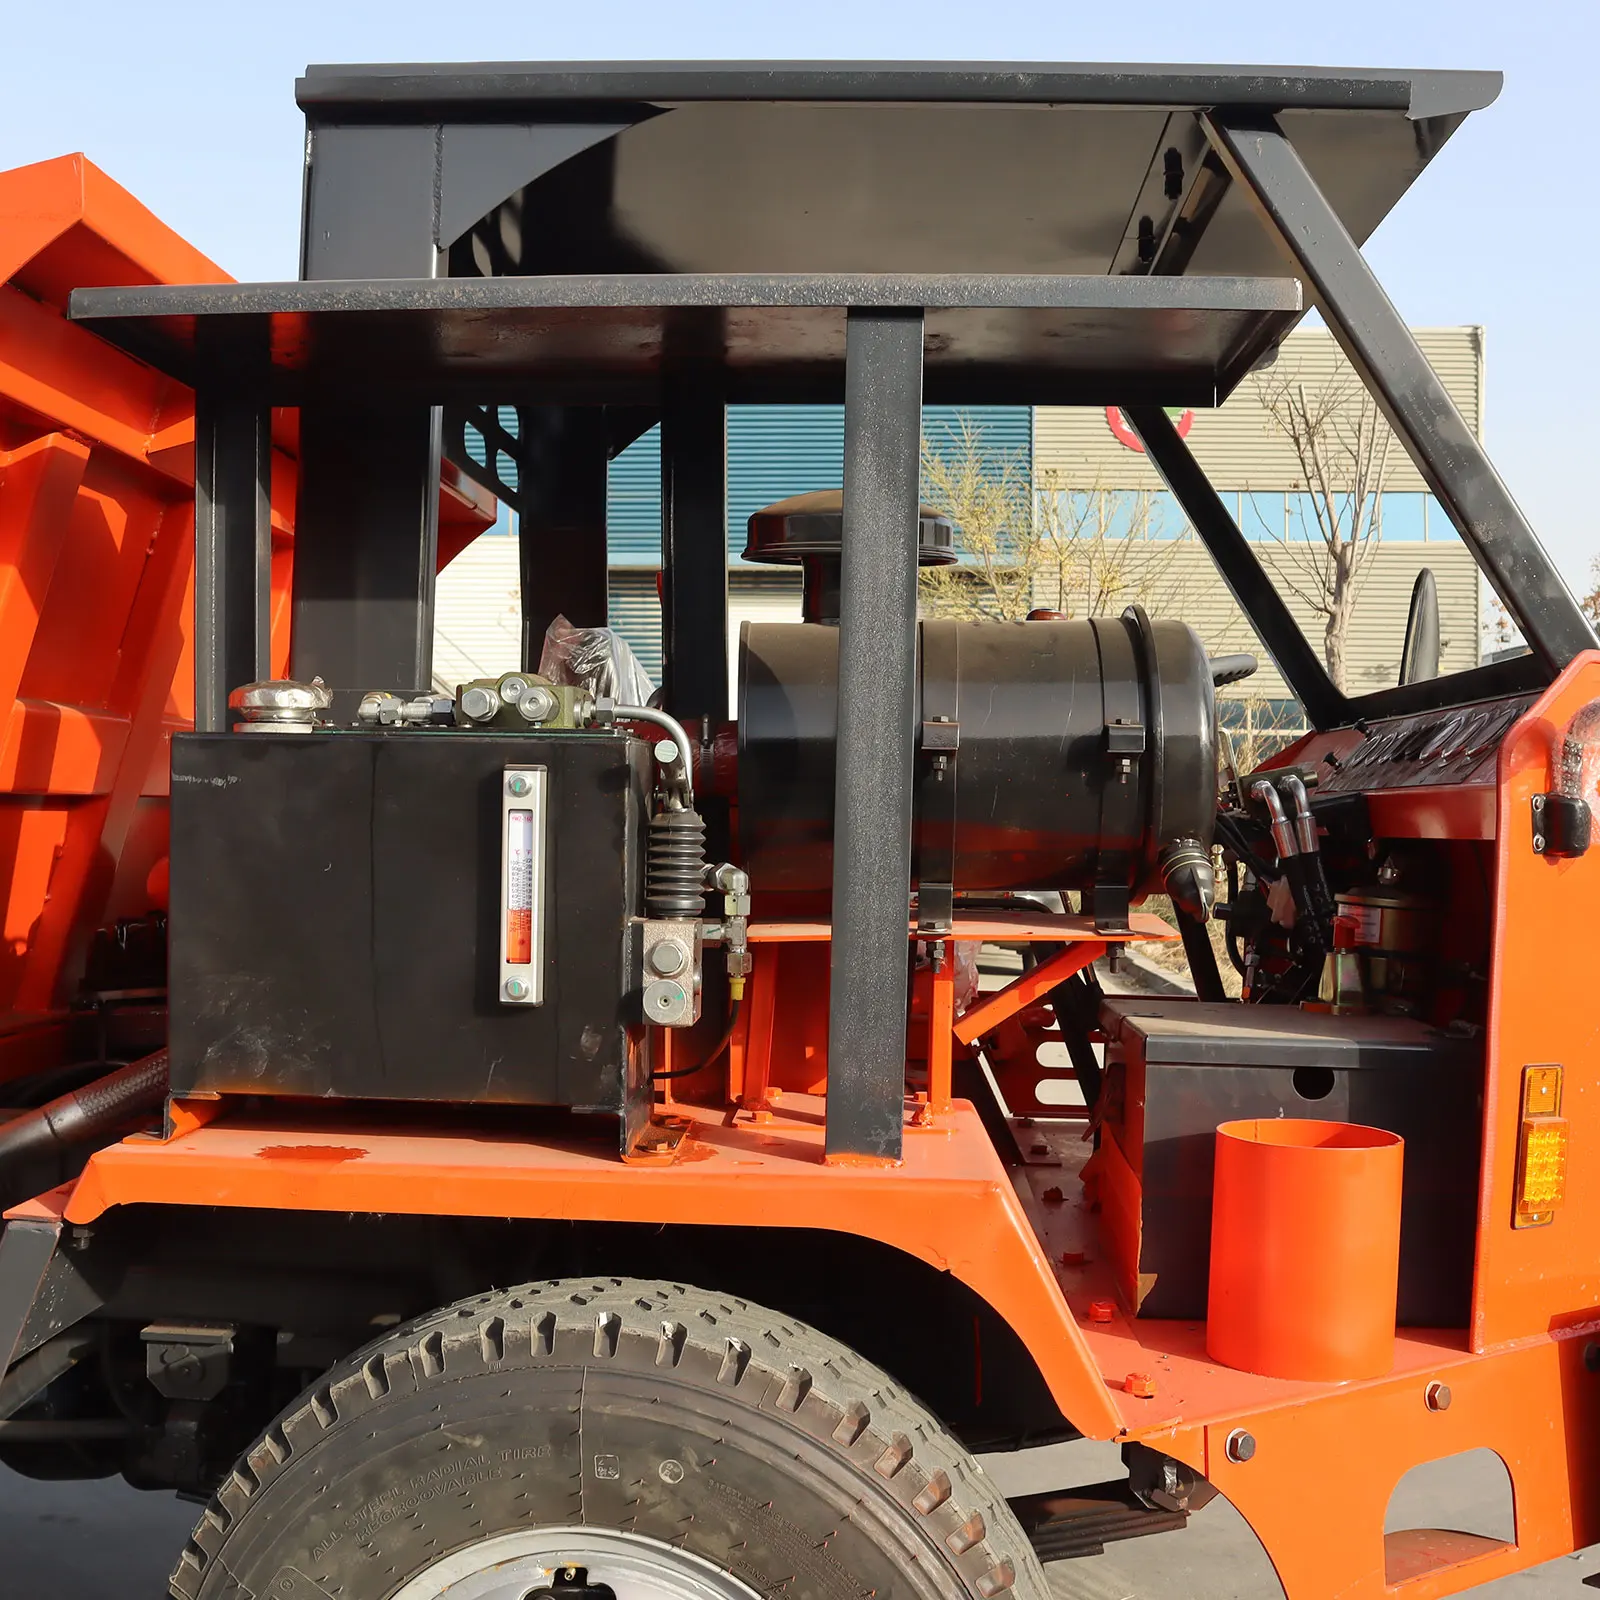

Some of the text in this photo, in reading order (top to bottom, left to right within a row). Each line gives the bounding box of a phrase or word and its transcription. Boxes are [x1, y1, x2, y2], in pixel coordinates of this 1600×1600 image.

[311, 1444, 552, 1562] ALL STEEL RADIAL TIRE
[352, 1467, 503, 1544] REGROOVABLE
